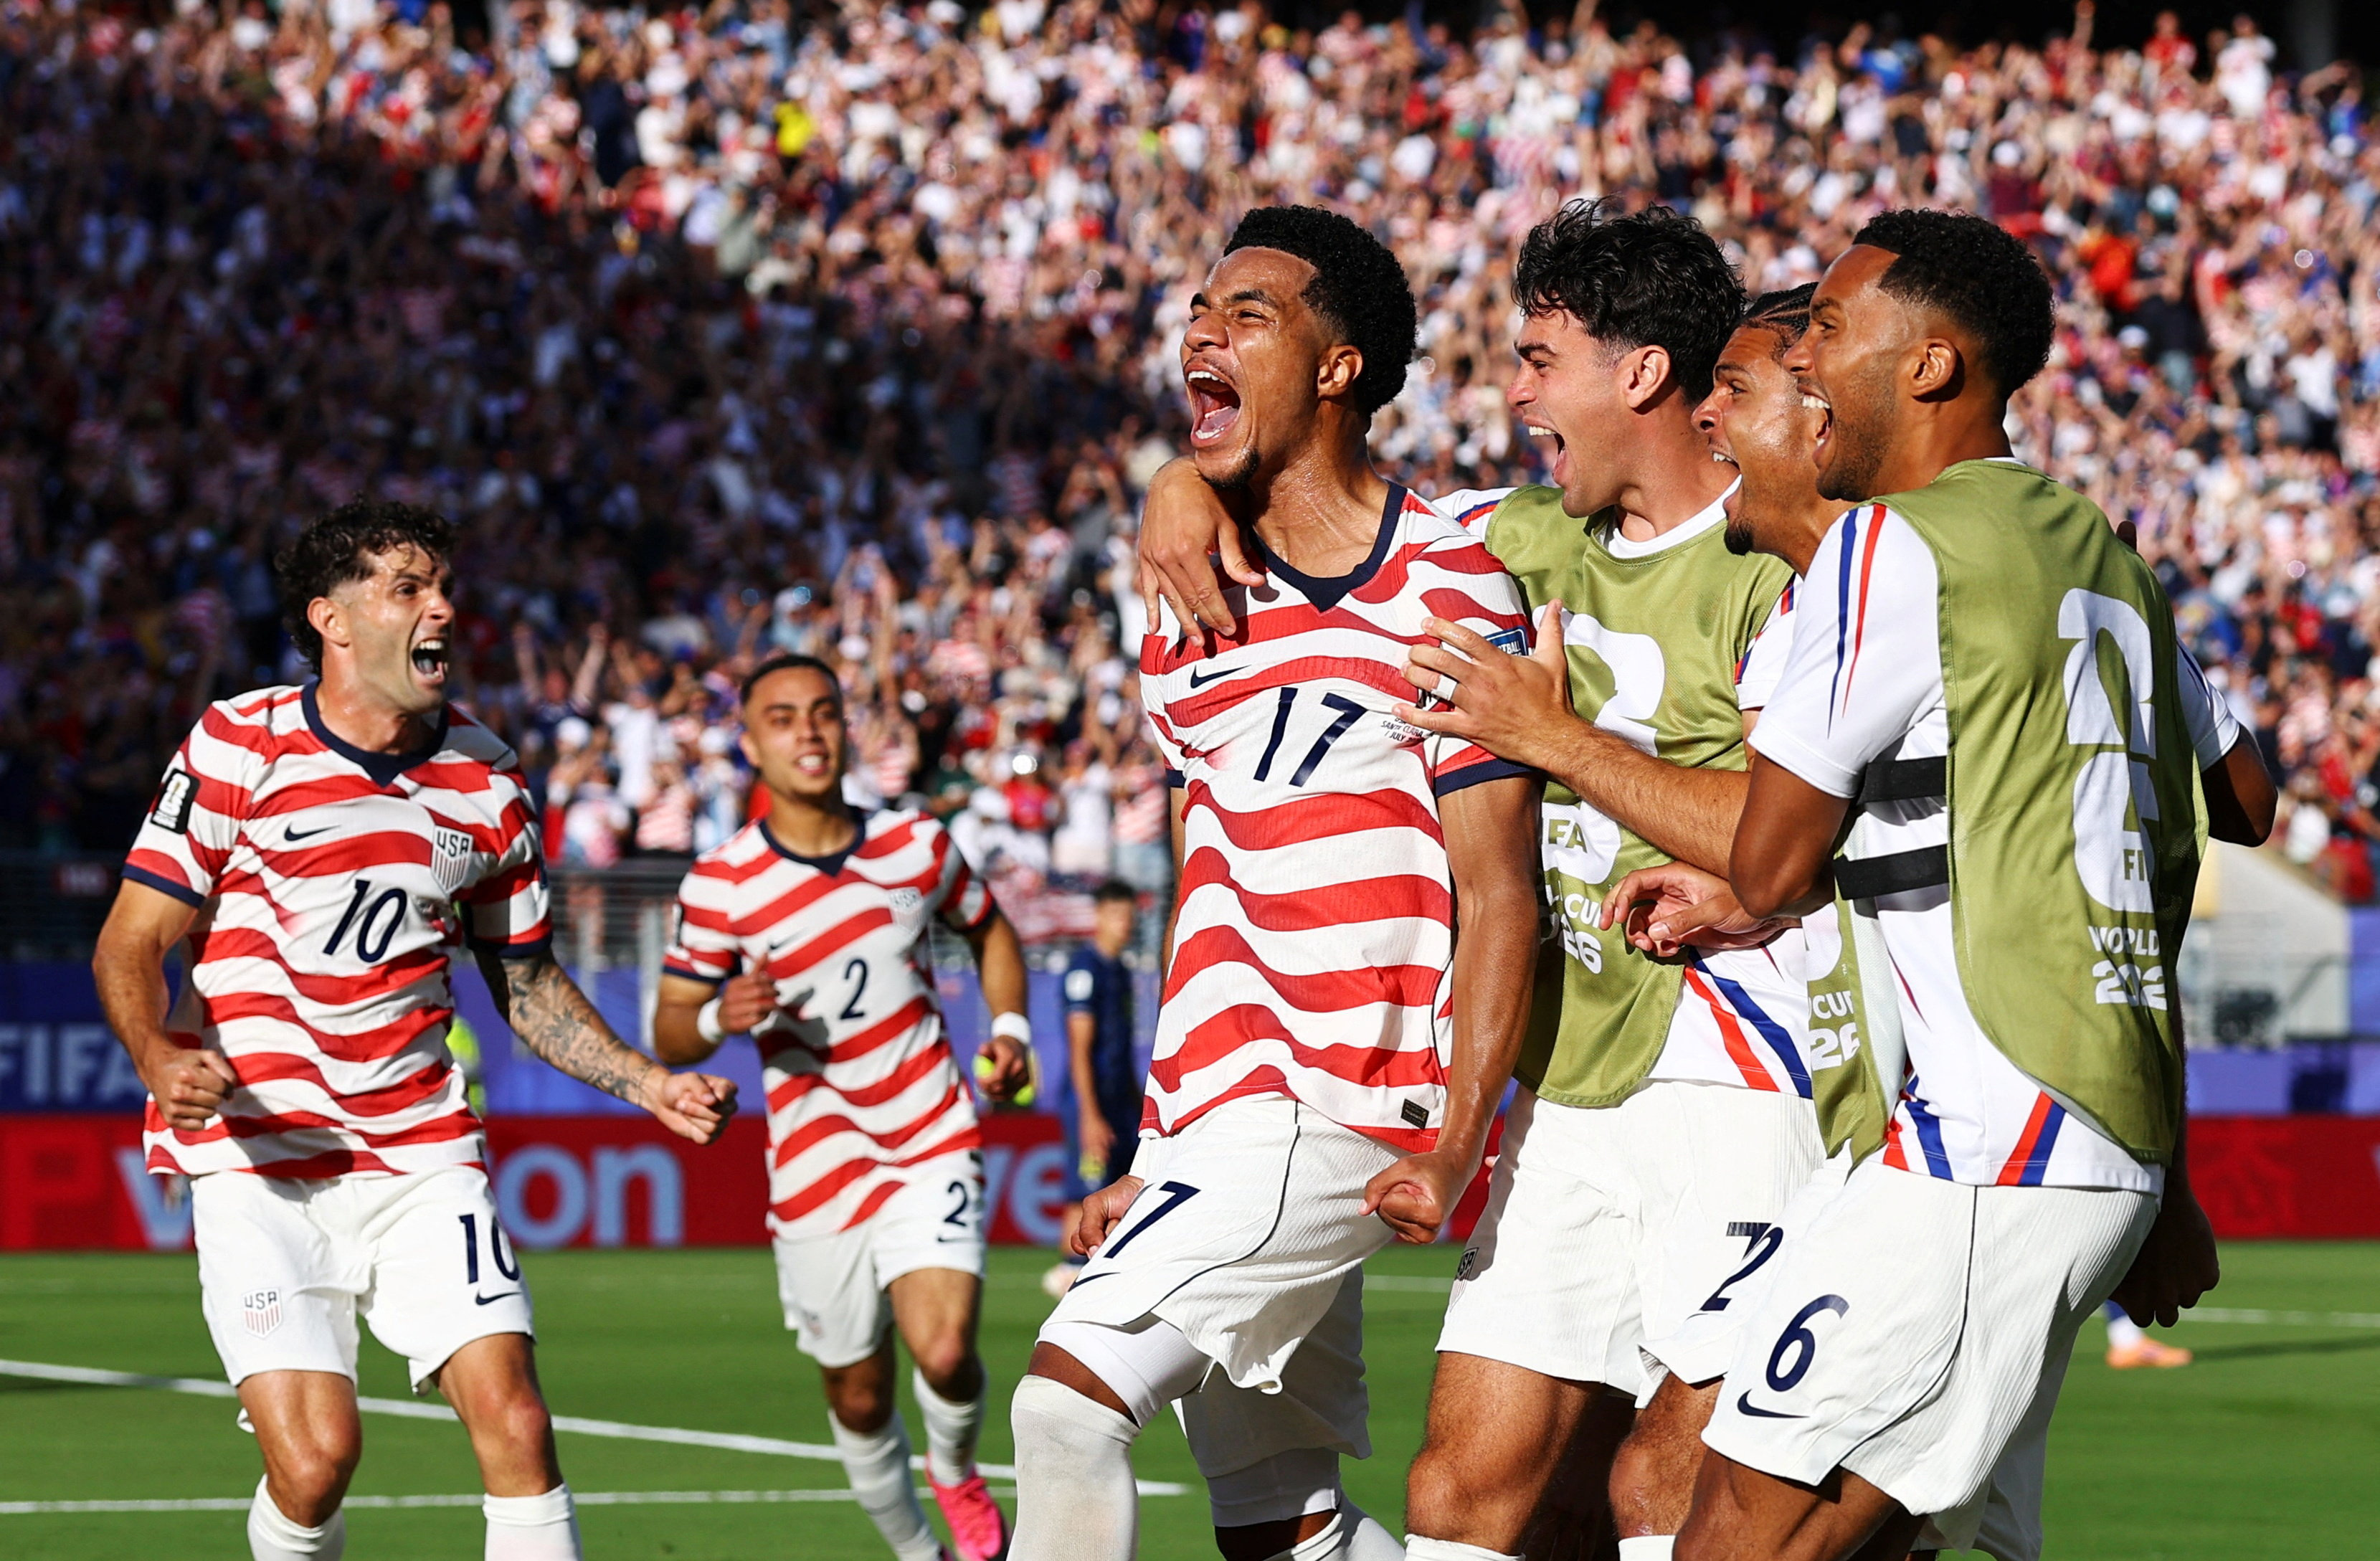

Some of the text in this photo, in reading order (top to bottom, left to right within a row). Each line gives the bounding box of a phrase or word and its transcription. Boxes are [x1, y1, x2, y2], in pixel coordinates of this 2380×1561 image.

[1253, 686, 1369, 787] 17
[1389, 731, 1406, 741] JULY
[437, 830, 470, 858] USA
[1547, 818, 1588, 853] FA
[2123, 848, 2146, 882] FI
[323, 879, 407, 962] 10
[840, 958, 868, 1020] 2
[2092, 959, 2168, 1012] 202
[1808, 1022, 1861, 1071] 26
[944, 1181, 969, 1227] 2
[1104, 1180, 1202, 1259] 7
[459, 1213, 520, 1284] 10
[245, 1291, 278, 1310] USA
[1765, 1294, 1850, 1392] 6
